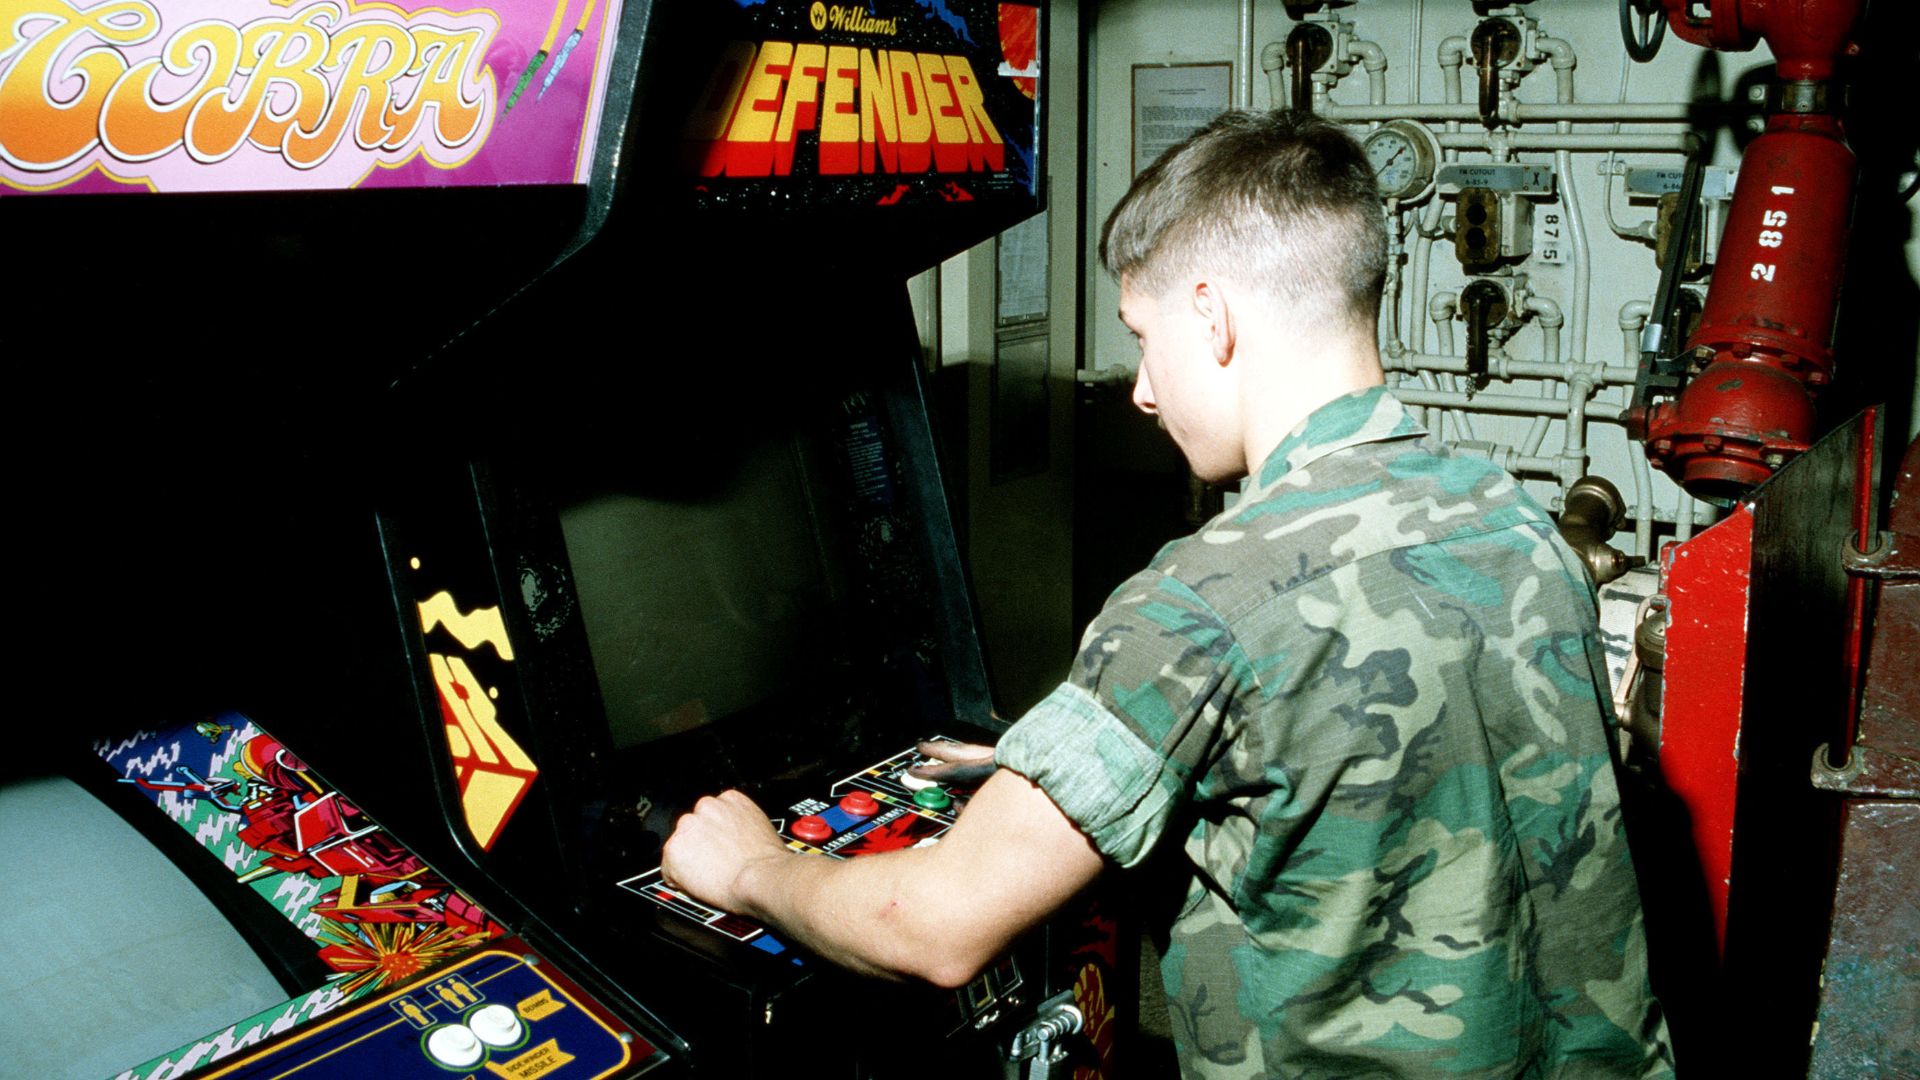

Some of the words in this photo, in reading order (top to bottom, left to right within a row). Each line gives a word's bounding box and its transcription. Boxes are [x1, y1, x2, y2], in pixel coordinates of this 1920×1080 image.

[829, 5, 897, 36] Williams
[0, 0, 489, 171] COBRA
[681, 40, 1006, 177] DEFENDER
[506, 1047, 549, 1072] SIDEWINDER
[519, 1055, 557, 1078] MISSILE
